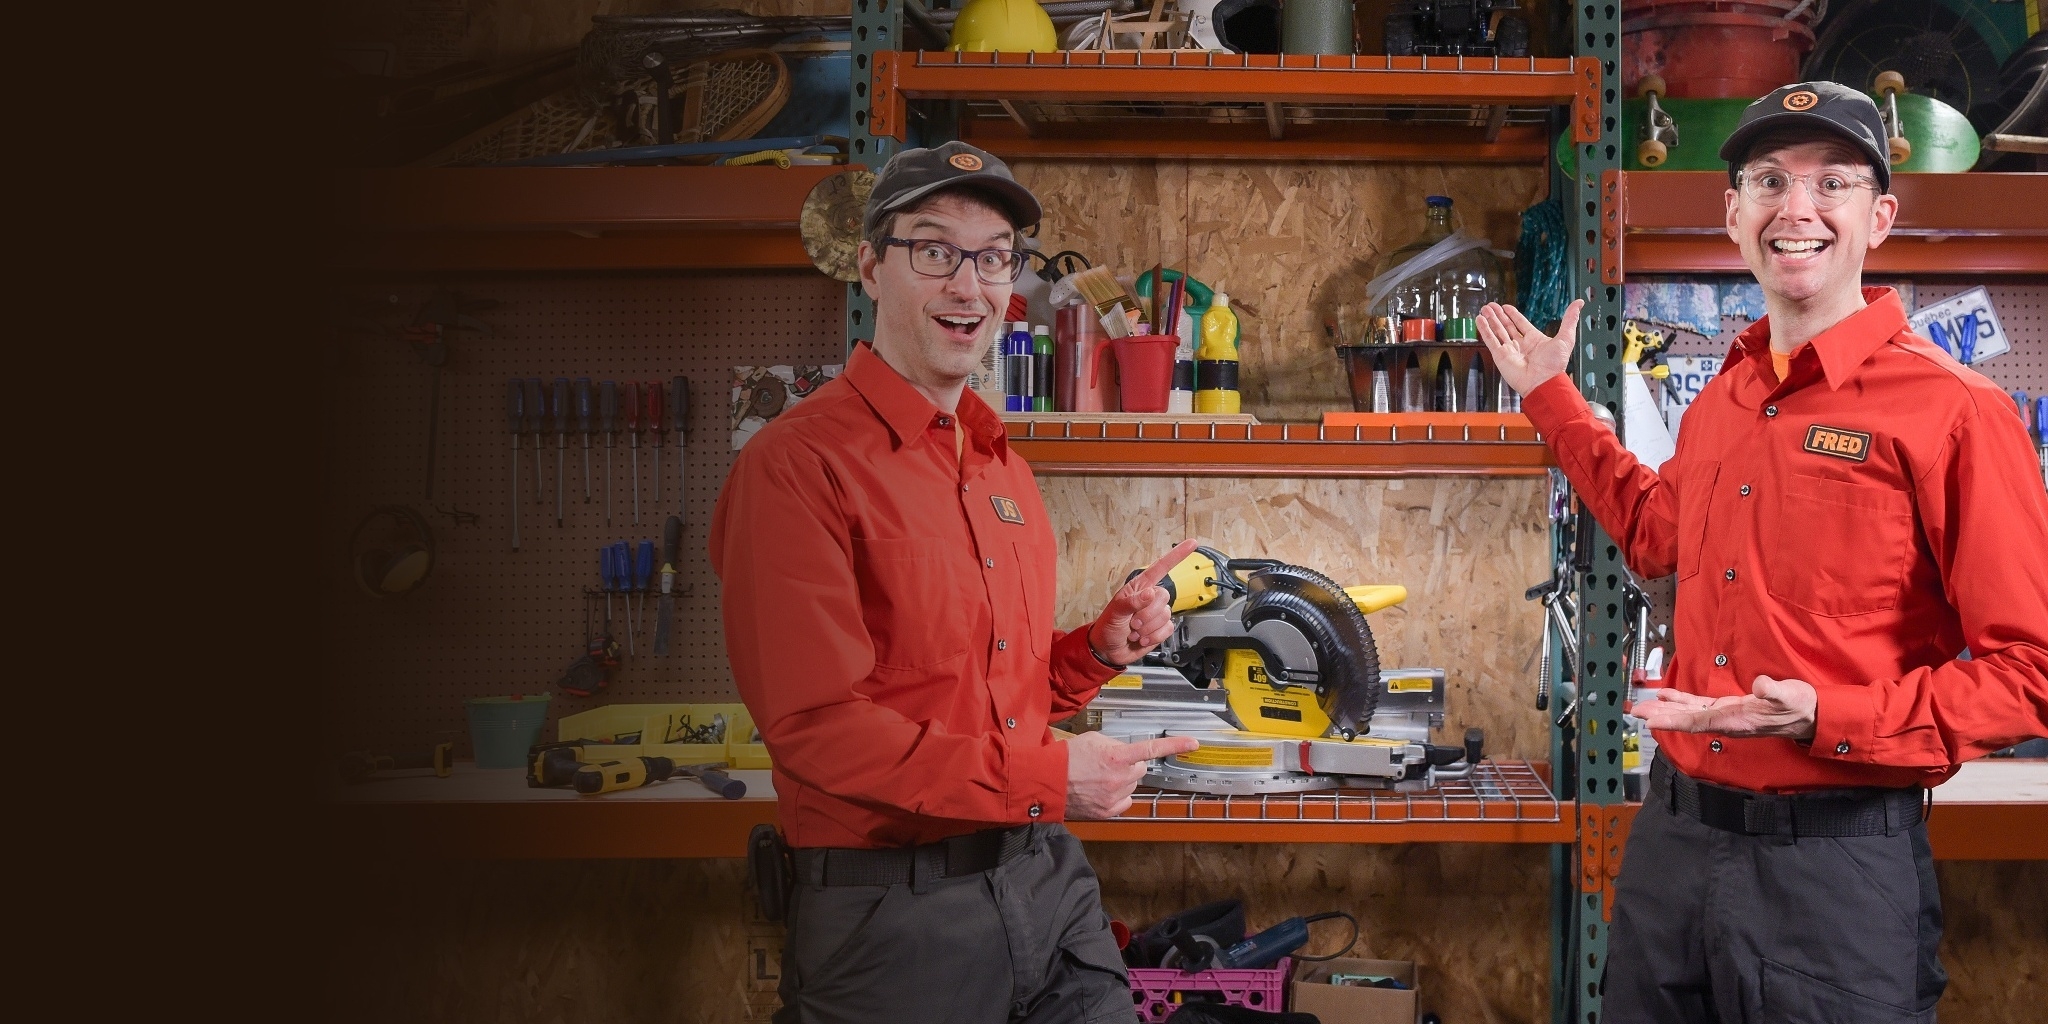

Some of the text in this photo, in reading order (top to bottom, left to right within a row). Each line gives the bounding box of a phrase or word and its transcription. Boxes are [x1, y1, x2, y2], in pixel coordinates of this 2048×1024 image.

[1908, 308, 1952, 331] Québec
[1811, 429, 1863, 454] FRED
[1253, 673, 1267, 684] 60T
[1264, 698, 1297, 706] CONSTRUCTION
